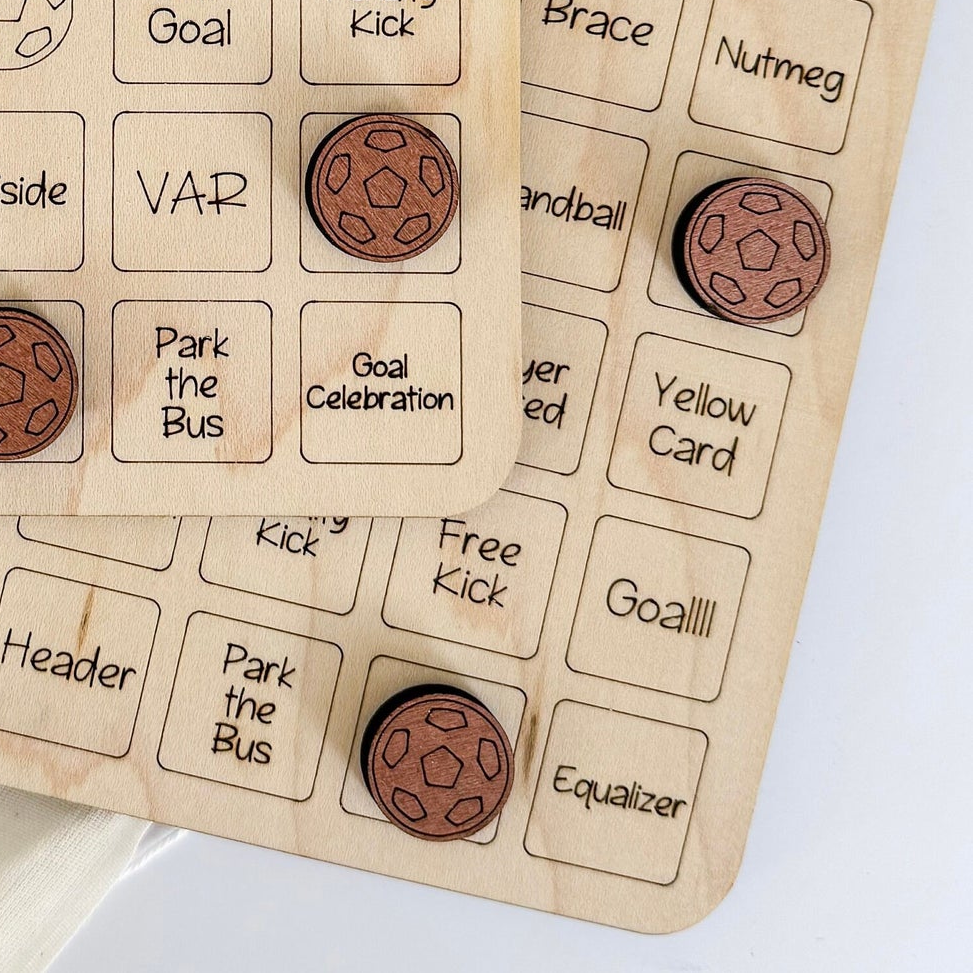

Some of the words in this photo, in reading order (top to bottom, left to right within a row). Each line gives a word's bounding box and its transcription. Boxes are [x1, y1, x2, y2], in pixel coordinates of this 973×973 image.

[149, 8, 231, 47] Goal
[350, 9, 414, 38] Kick
[715, 36, 845, 103] Nutmeg
[137, 170, 247, 215] VAR
[521, 185, 627, 231] andball
[155, 327, 229, 359] Park
[165, 367, 218, 399] the
[353, 352, 408, 379] Goal
[306, 384, 454, 411] Celebration
[655, 372, 757, 427] Yellow
[161, 406, 224, 439] Bus
[648, 425, 739, 477] Card
[256, 518, 320, 557] Kick
[440, 518, 521, 567] Free
[433, 562, 508, 608] Kick
[1, 628, 137, 691] Header
[222, 643, 296, 689] Park
[225, 687, 277, 725] the
[211, 723, 272, 765] Bus
[552, 765, 688, 820] Equalizer
